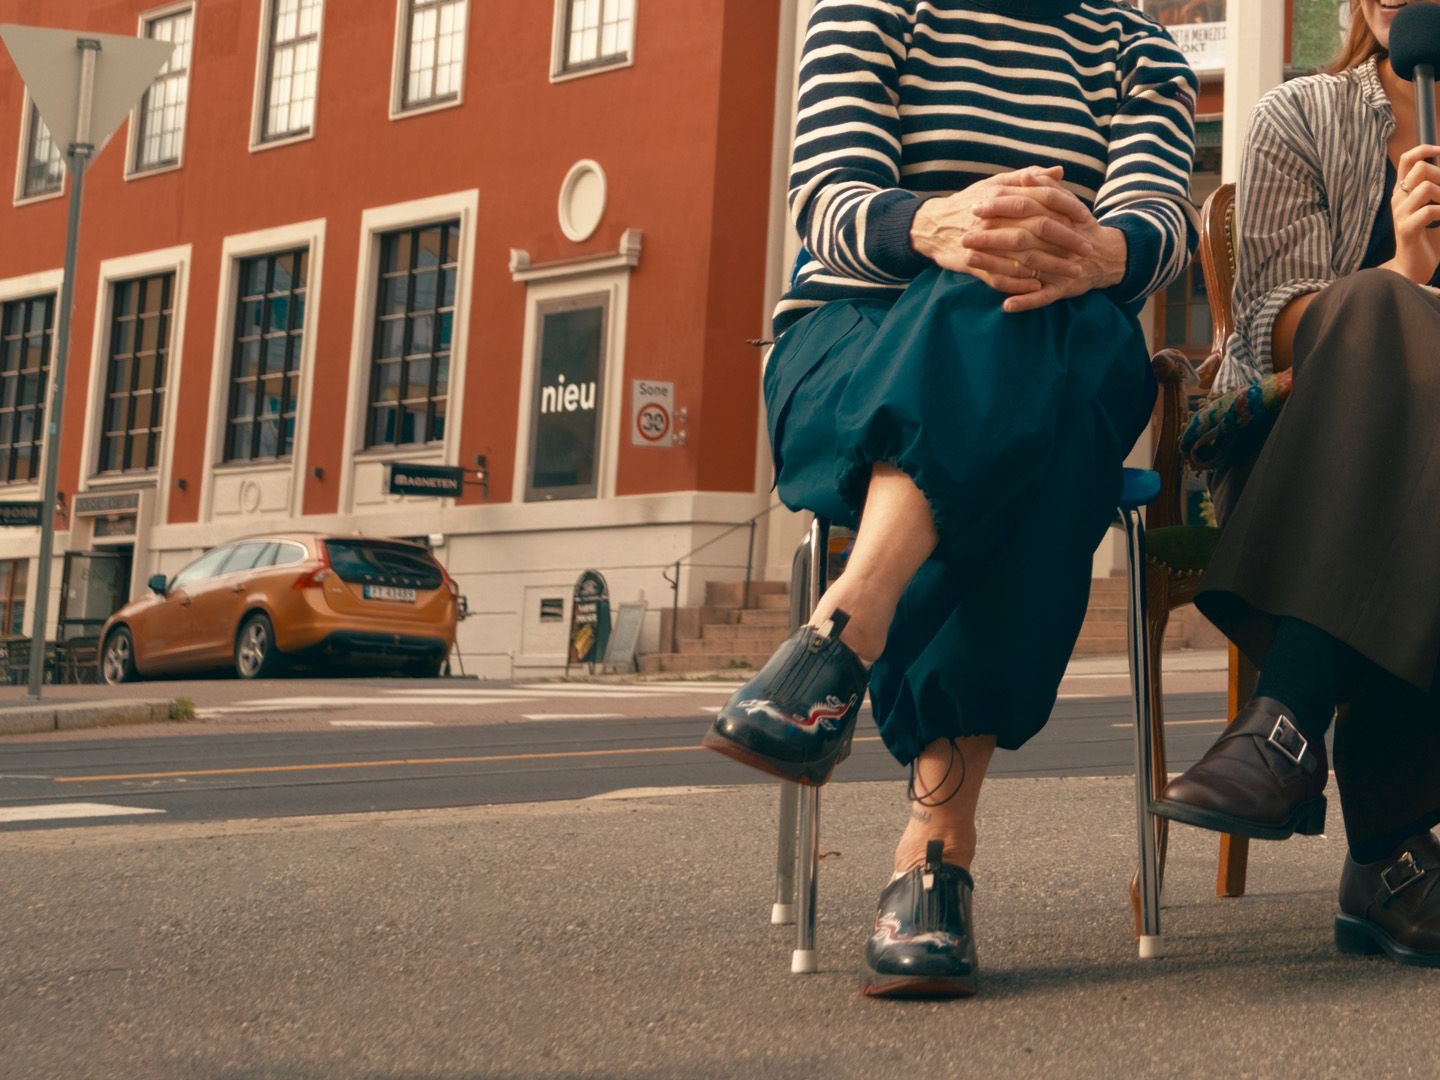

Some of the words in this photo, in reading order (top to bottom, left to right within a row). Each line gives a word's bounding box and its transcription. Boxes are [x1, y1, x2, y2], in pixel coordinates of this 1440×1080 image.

[541, 373, 596, 414] nieu
[639, 382, 669, 397] Sone
[642, 412, 664, 432] 30
[394, 473, 458, 489] MAGNETEN
